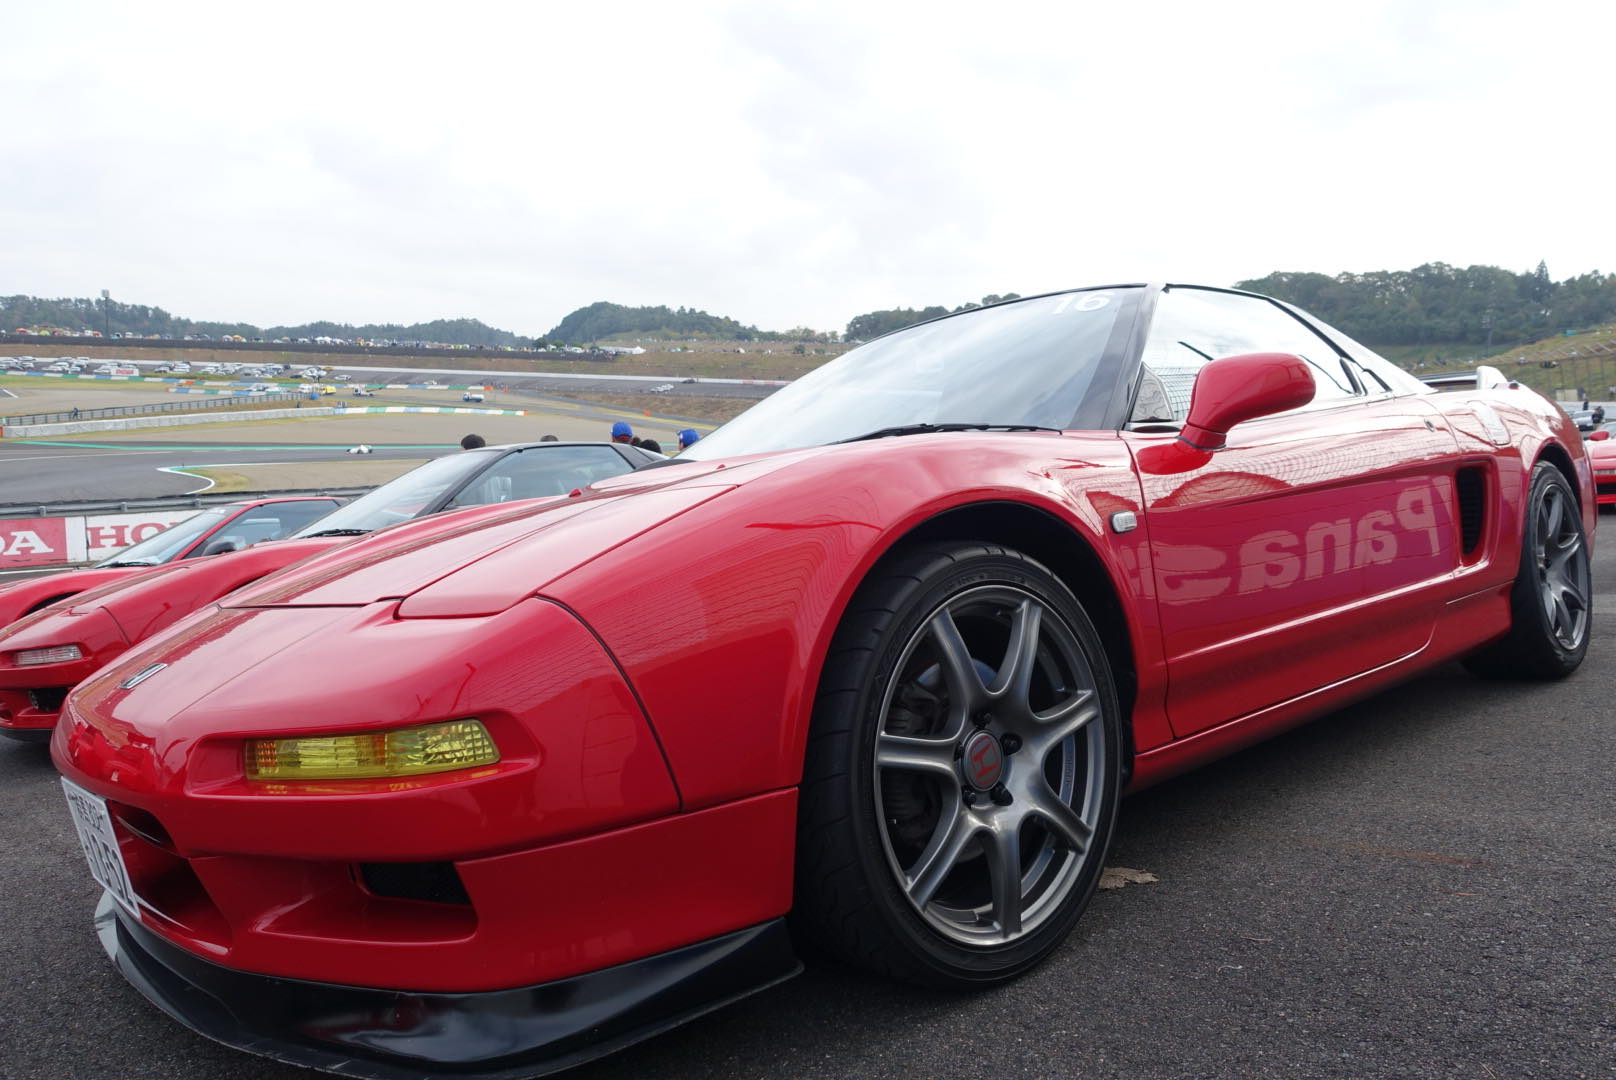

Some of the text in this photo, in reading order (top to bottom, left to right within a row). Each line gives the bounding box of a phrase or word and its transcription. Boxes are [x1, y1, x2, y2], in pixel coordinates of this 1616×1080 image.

[1053, 290, 1112, 314] 16
[0, 530, 55, 556] A
[86, 521, 181, 549] HO
